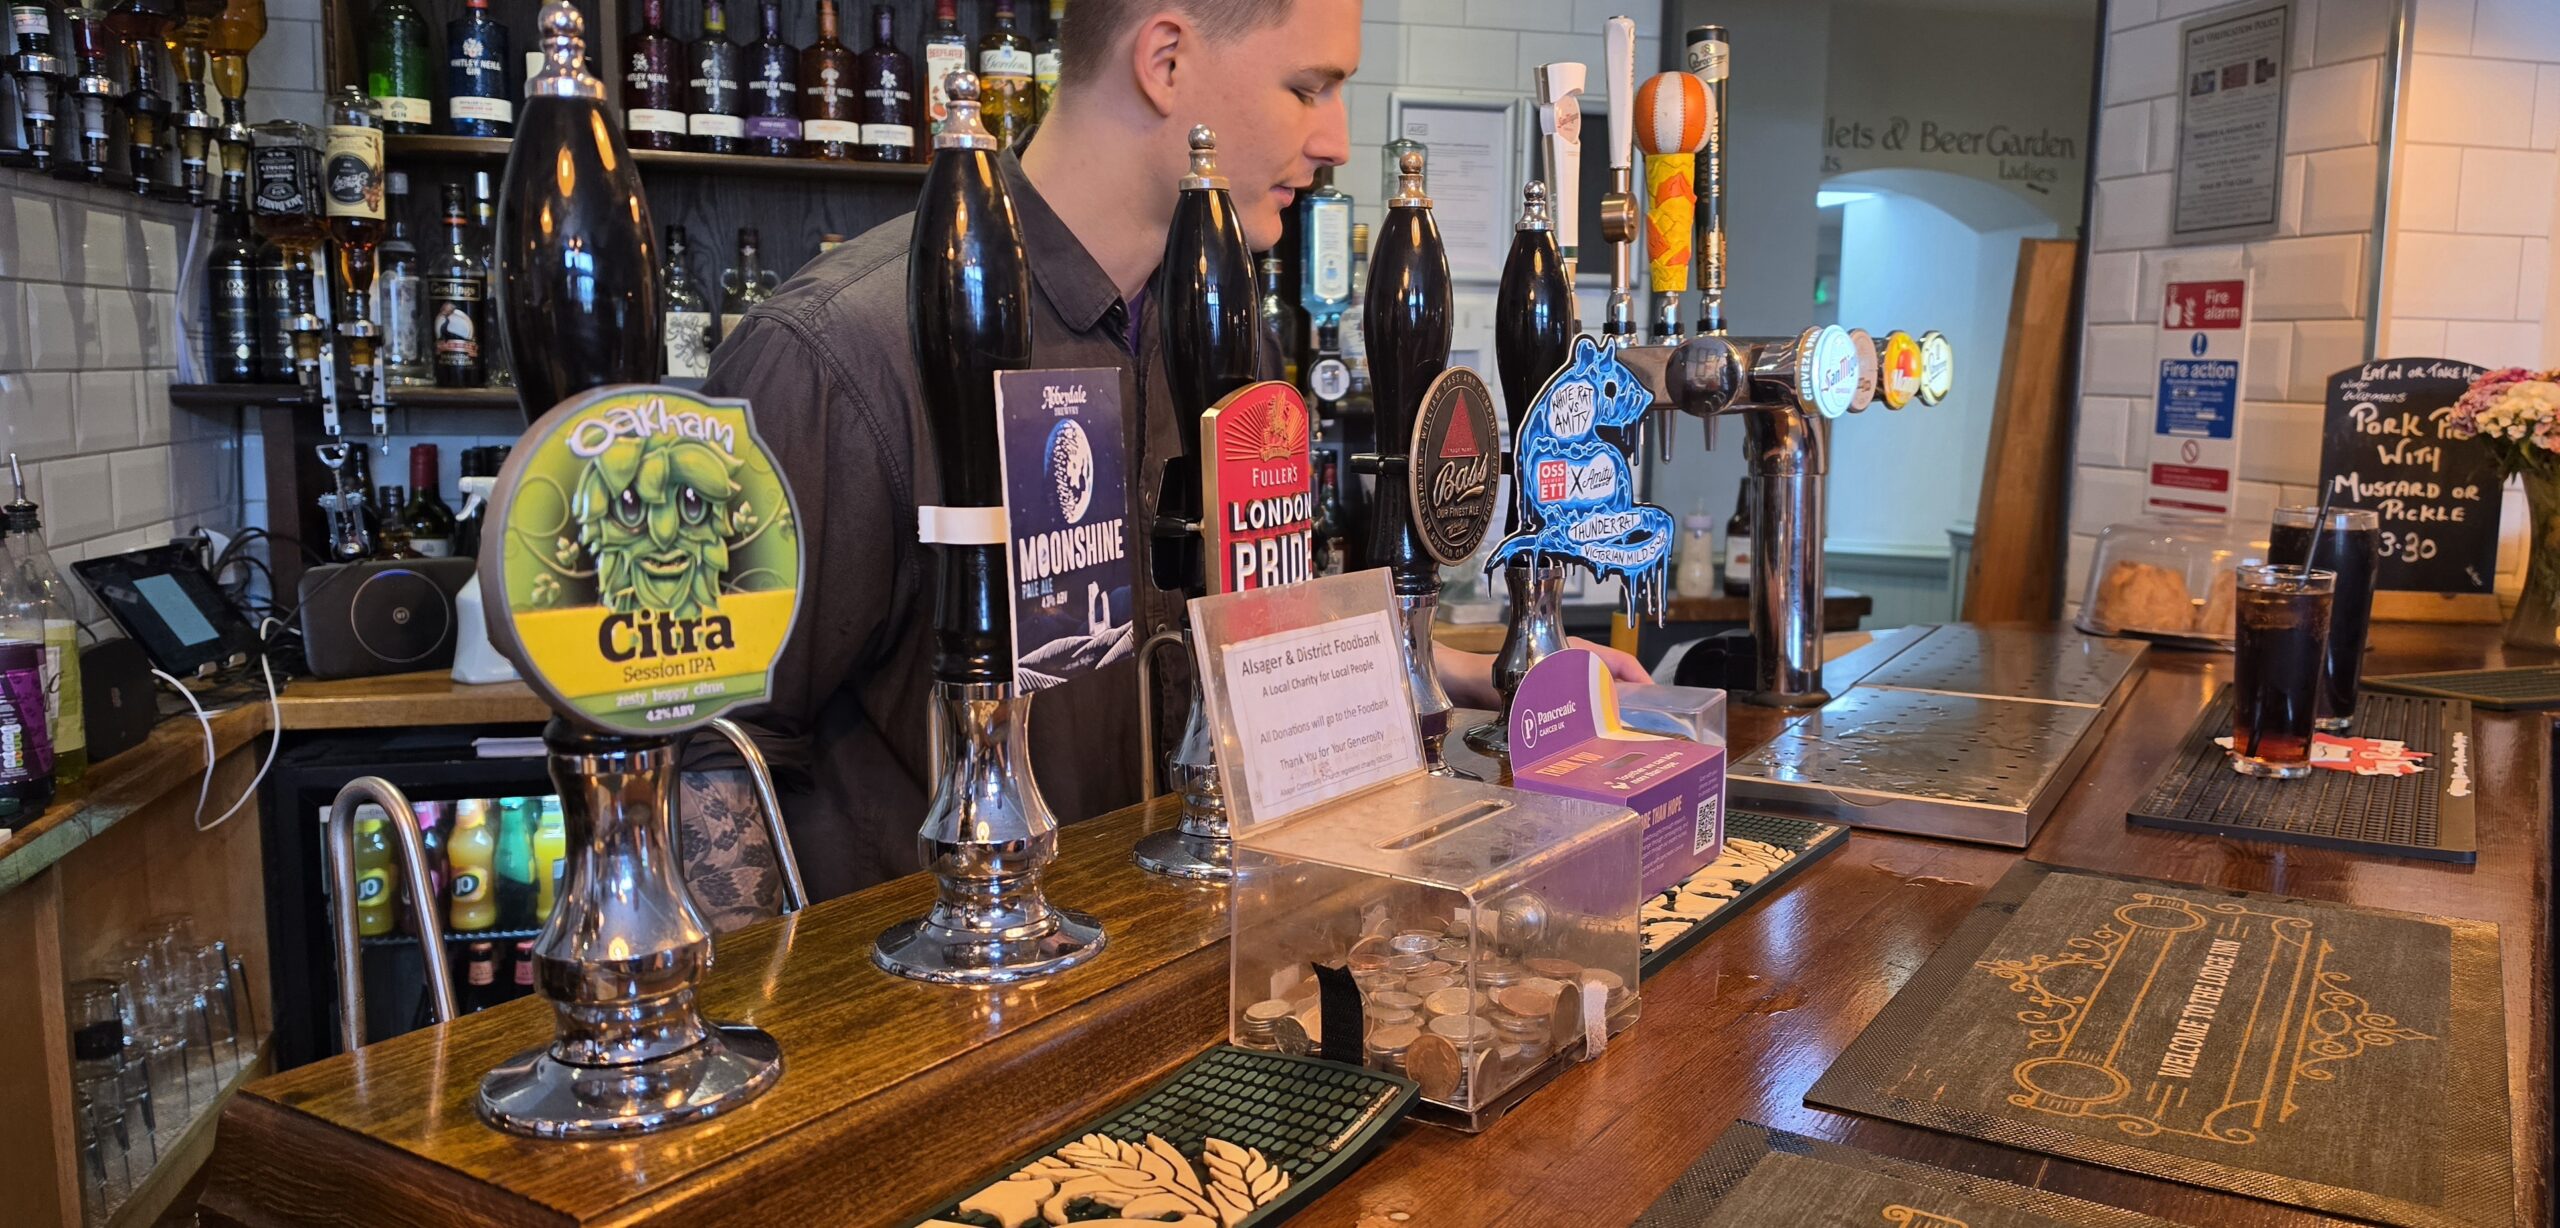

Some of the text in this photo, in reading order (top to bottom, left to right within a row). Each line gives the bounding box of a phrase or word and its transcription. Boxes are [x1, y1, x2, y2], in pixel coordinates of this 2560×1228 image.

[466, 67, 481, 77] GIN
[480, 60, 502, 71] NEILL
[390, 109, 408, 119] GIN
[1881, 115, 1911, 151] &
[1920, 120, 1985, 155] Beer
[1986, 123, 2077, 160] Garden
[1710, 157, 1720, 182] THE
[2000, 159, 2059, 183] Ladies
[2205, 289, 2231, 305] Fire
[2203, 304, 2240, 321] alarm
[1801, 350, 1813, 401] CERVEZA
[2162, 360, 2236, 381] Fire action
[2407, 367, 2427, 379] OR
[2427, 362, 2461, 380] TAKE
[1041, 384, 1088, 410] Abbeydale
[1420, 374, 1497, 440] WILLIAM BASS AND COMPANY
[1552, 384, 1594, 413] WHITE RAT
[1568, 401, 1579, 413] VS
[1053, 405, 1079, 417] BREWERY
[1554, 410, 1591, 434] AMITY
[569, 398, 735, 458] Oakham
[2377, 437, 2442, 473] WITH
[1252, 463, 1299, 488] FULLER'S
[1433, 452, 1488, 507] Bass
[1541, 463, 1565, 478] OSS
[1569, 466, 1585, 497] X
[1582, 467, 1615, 488] Amity
[1541, 483, 1565, 499] ETT
[2334, 471, 2481, 503] MUSTARD OR
[1232, 492, 1312, 532] LONDON
[1430, 531, 1453, 558] BURTON
[1455, 548, 1464, 558] ON
[1484, 489, 1496, 524] SINCE
[1436, 505, 1479, 519] OUR FINEST ALE
[1570, 512, 1639, 540] THUNDER RAT
[1018, 518, 1125, 583] MOONSHINE
[1234, 529, 1314, 593] PRIDE
[1584, 545, 1625, 564] VICTORIAN
[1626, 549, 1649, 563] MILD
[1021, 577, 1054, 600] PALE ALE
[1056, 590, 1069, 605] ABV
[598, 609, 736, 664] Citra
[1241, 630, 1382, 677] Alsager & District Foodbank
[623, 657, 716, 683] Session IPA
[1262, 660, 1375, 698] A Local Charity for Local People
[616, 681, 726, 708] zesty hoppy citrus
[645, 703, 696, 722] 4.2% ABV
[1260, 697, 1390, 745] All Donations will go to the Foodbank
[1537, 700, 1577, 726] Pancreatic
[1539, 721, 1566, 737] CANCER UK
[1280, 730, 1386, 771] Thank You for Your Generosity
[1535, 760, 1588, 777] THANK
[1614, 767, 1647, 781] Together
[1652, 802, 1668, 826] THAN
[1667, 794, 1683, 818] HOPE
[2157, 938, 2242, 1079] WELCOME TO THE LODGE INN
